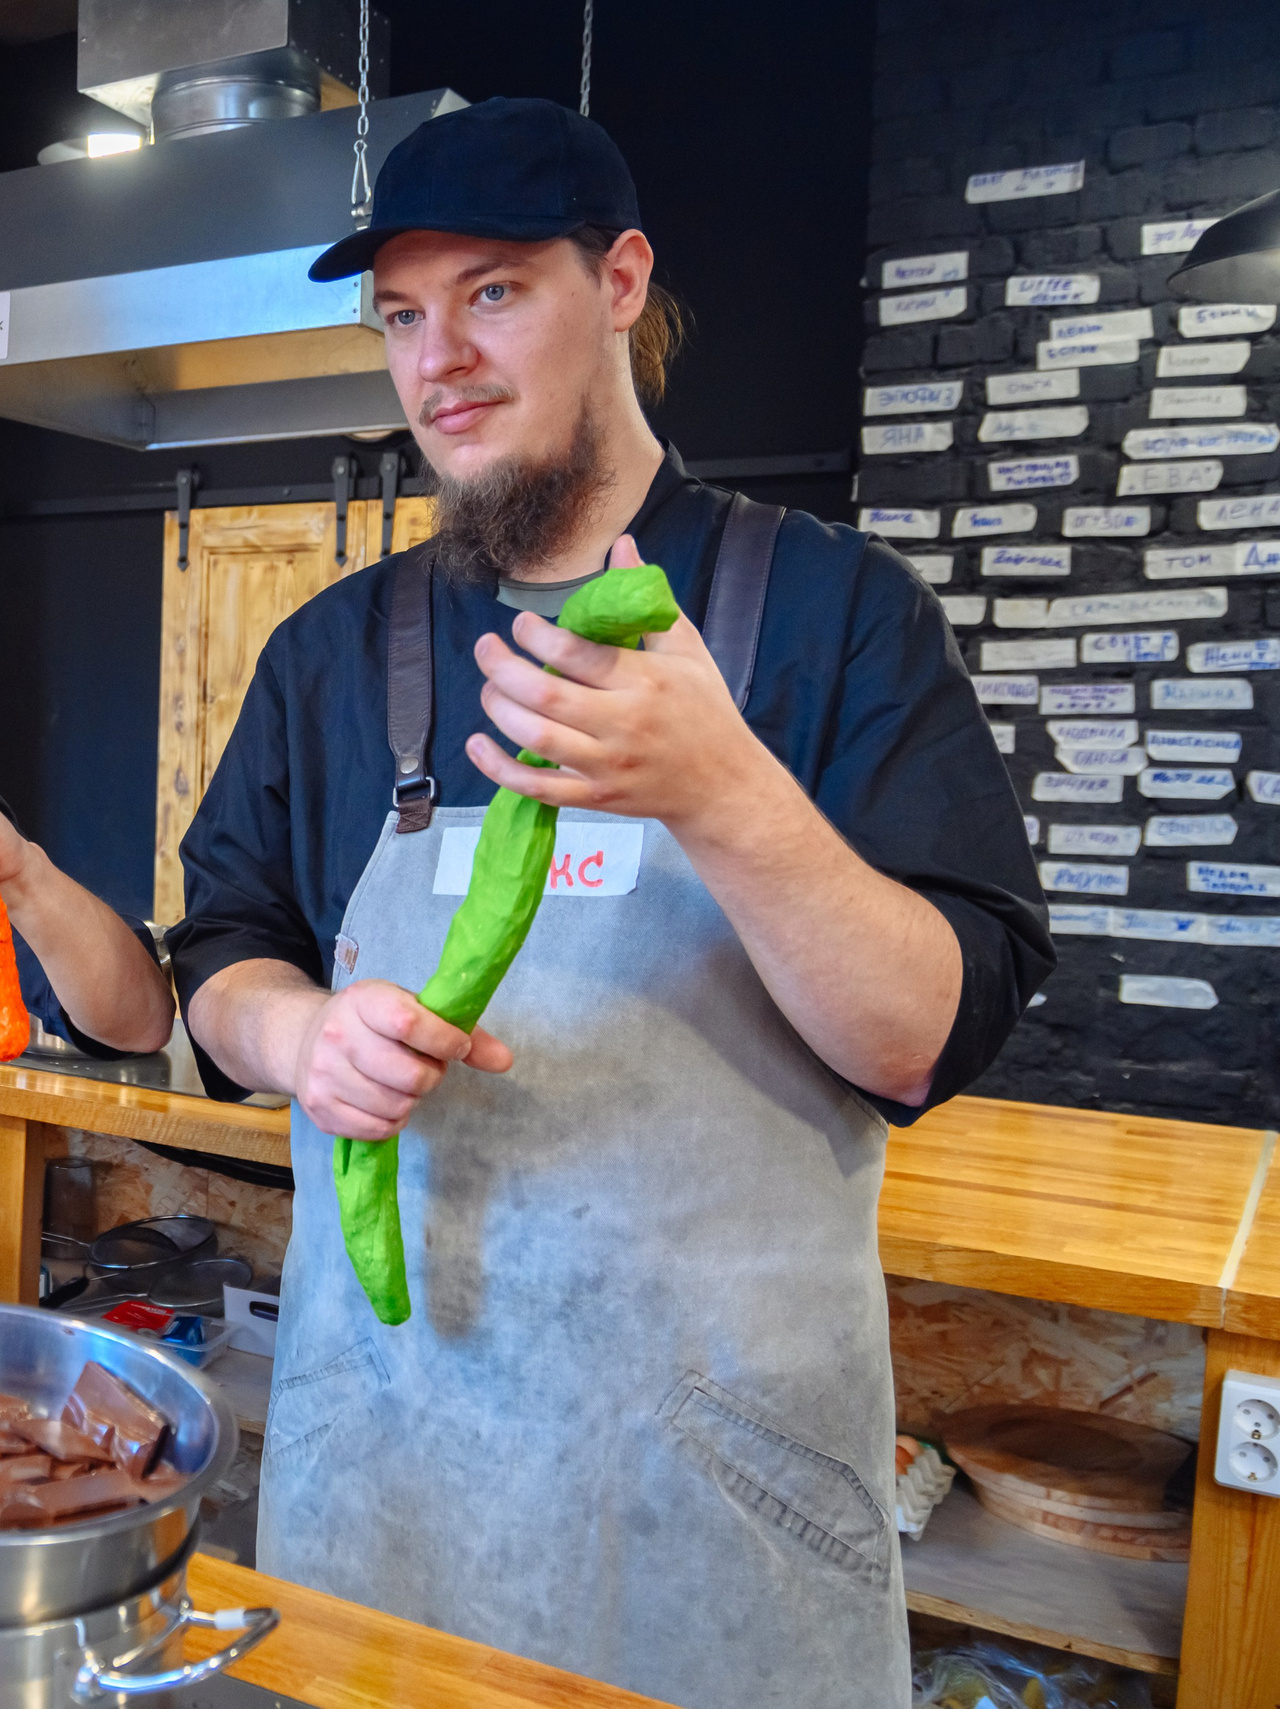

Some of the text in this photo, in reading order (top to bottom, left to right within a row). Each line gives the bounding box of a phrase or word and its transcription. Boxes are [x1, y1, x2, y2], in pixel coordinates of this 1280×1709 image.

[879, 425, 925, 448] ЯНА
[1163, 553, 1212, 570] ТОМ
[549, 850, 604, 889] КС
